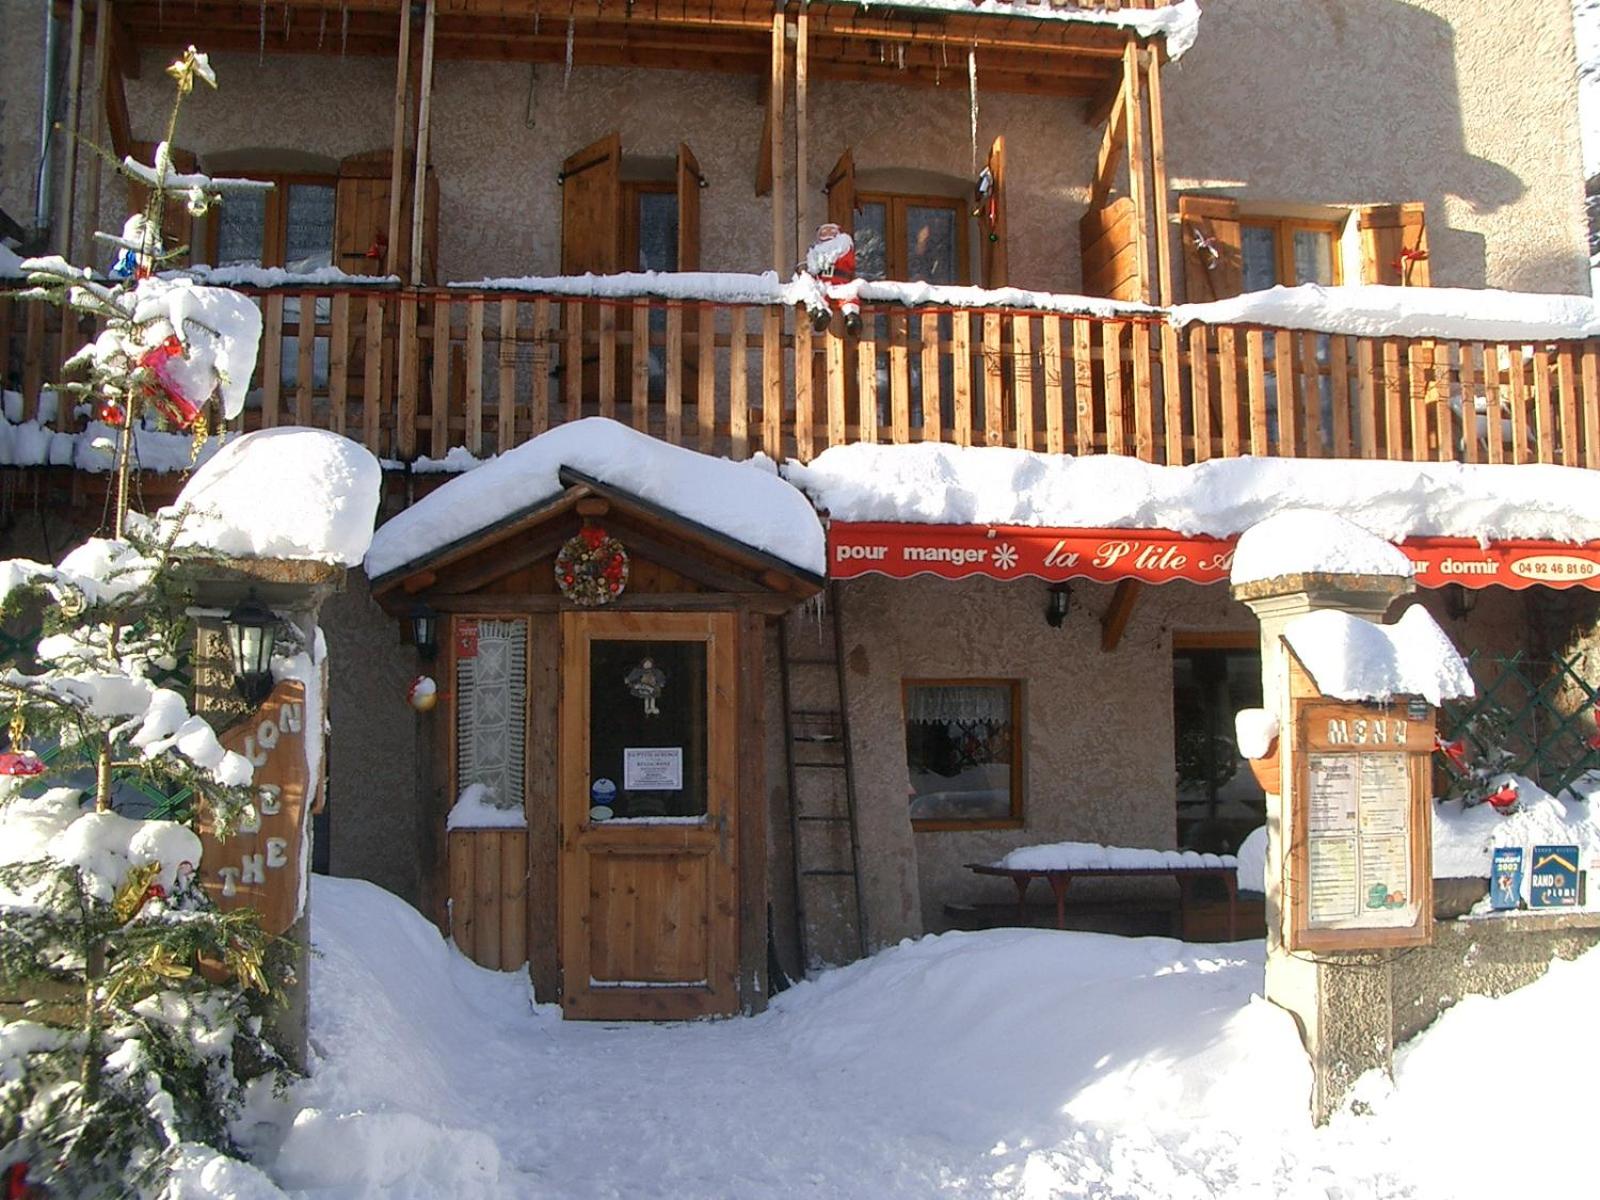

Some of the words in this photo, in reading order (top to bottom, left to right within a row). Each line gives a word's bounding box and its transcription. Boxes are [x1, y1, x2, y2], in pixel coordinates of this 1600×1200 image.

[836, 544, 888, 562] pour
[903, 545, 988, 564] manger
[1042, 540, 1081, 568] la
[1440, 557, 1500, 575] dormir
[1519, 562, 1532, 573] 04
[1535, 563, 1548, 574] 92
[1550, 563, 1564, 574] 46
[1566, 563, 1578, 574] 81
[1580, 564, 1594, 574] 60
[218, 836, 288, 897] THE
